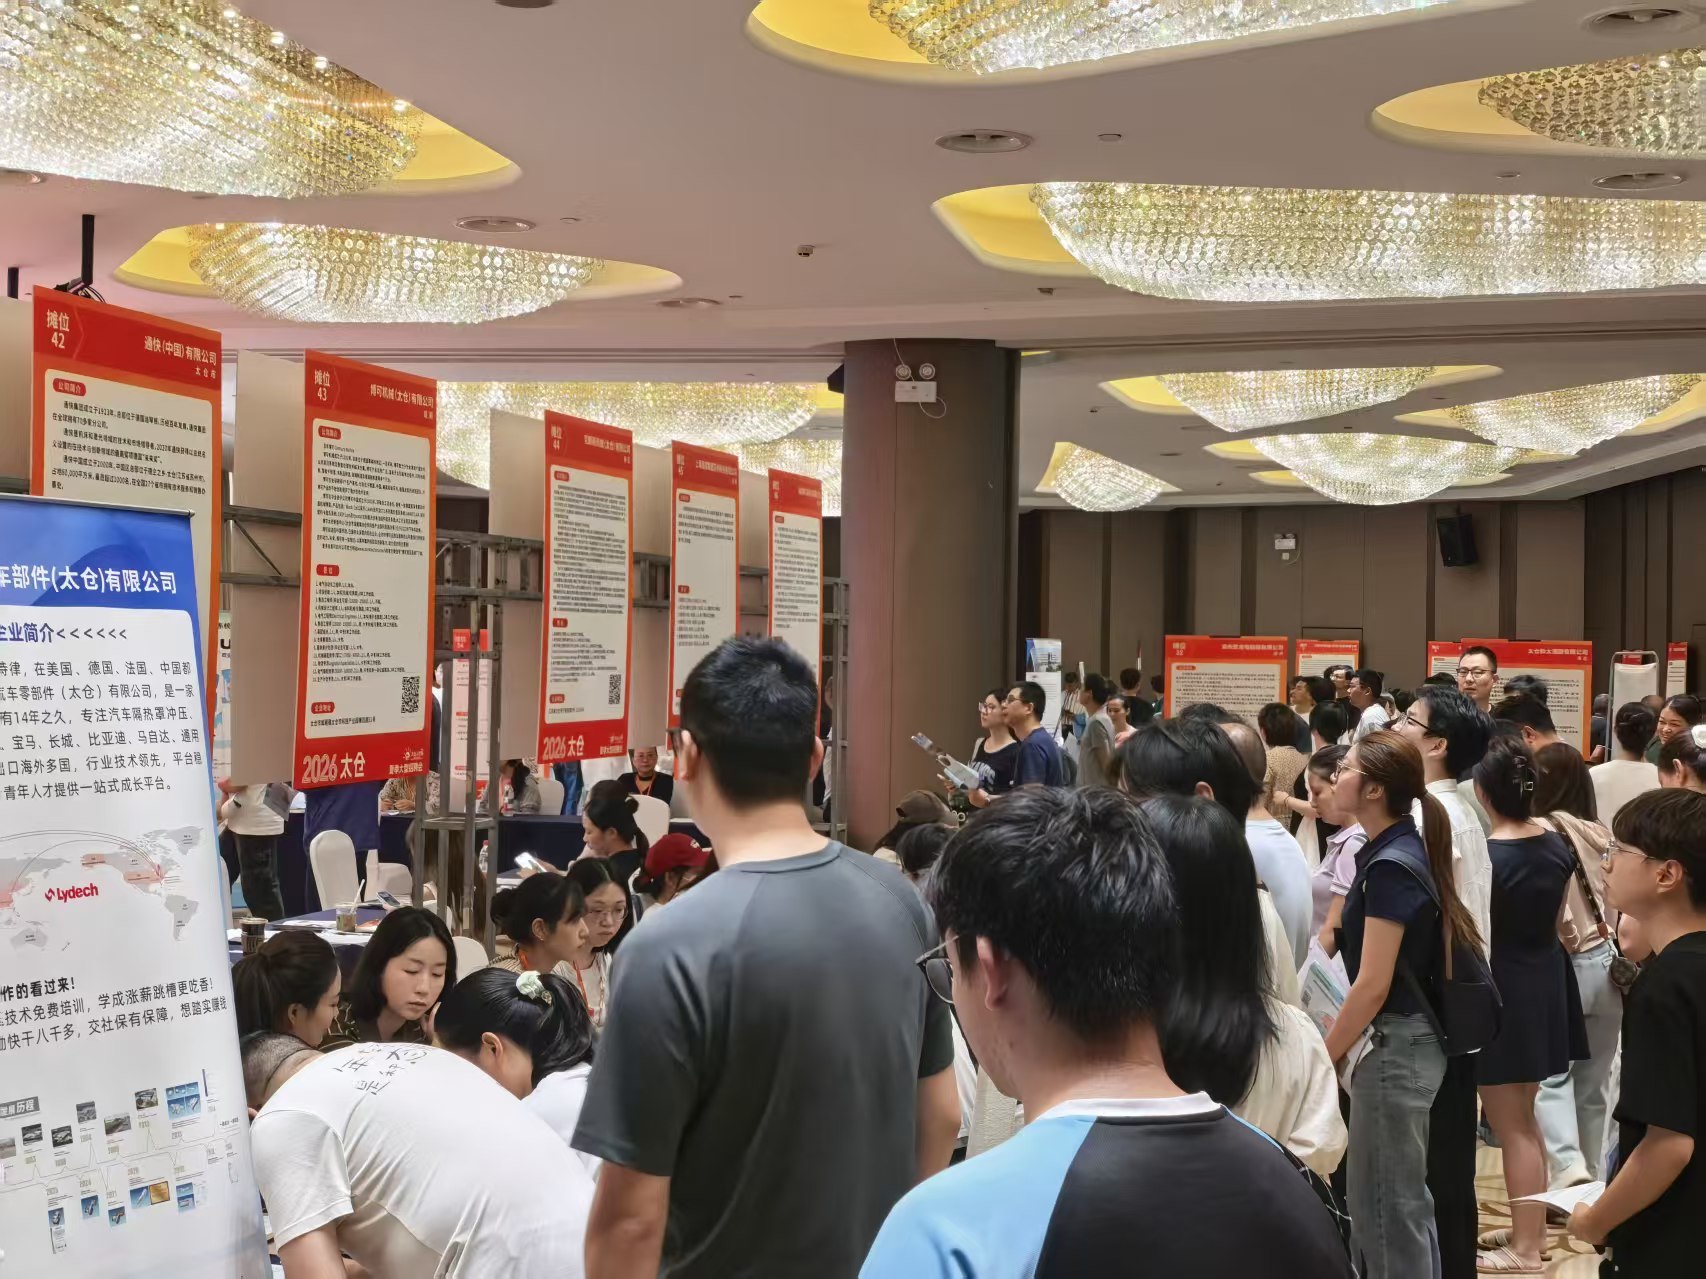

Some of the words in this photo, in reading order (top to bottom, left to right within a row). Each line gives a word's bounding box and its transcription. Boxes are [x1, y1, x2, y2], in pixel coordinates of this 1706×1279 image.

[46, 309, 70, 332] 摊位
[51, 332, 66, 349] 42
[144, 336, 217, 366] 通快(中国)有限公司
[317, 387, 328, 401] 43
[0, 706, 194, 726] 有14年之久，专注汽车隔热罩冲压、
[542, 735, 565, 761] 2026
[567, 735, 585, 757] 太仓
[302, 753, 338, 784] 2026
[339, 751, 366, 779] 太仓
[56, 882, 99, 903] Lydech
[0, 977, 76, 1003] 作的看过来！
